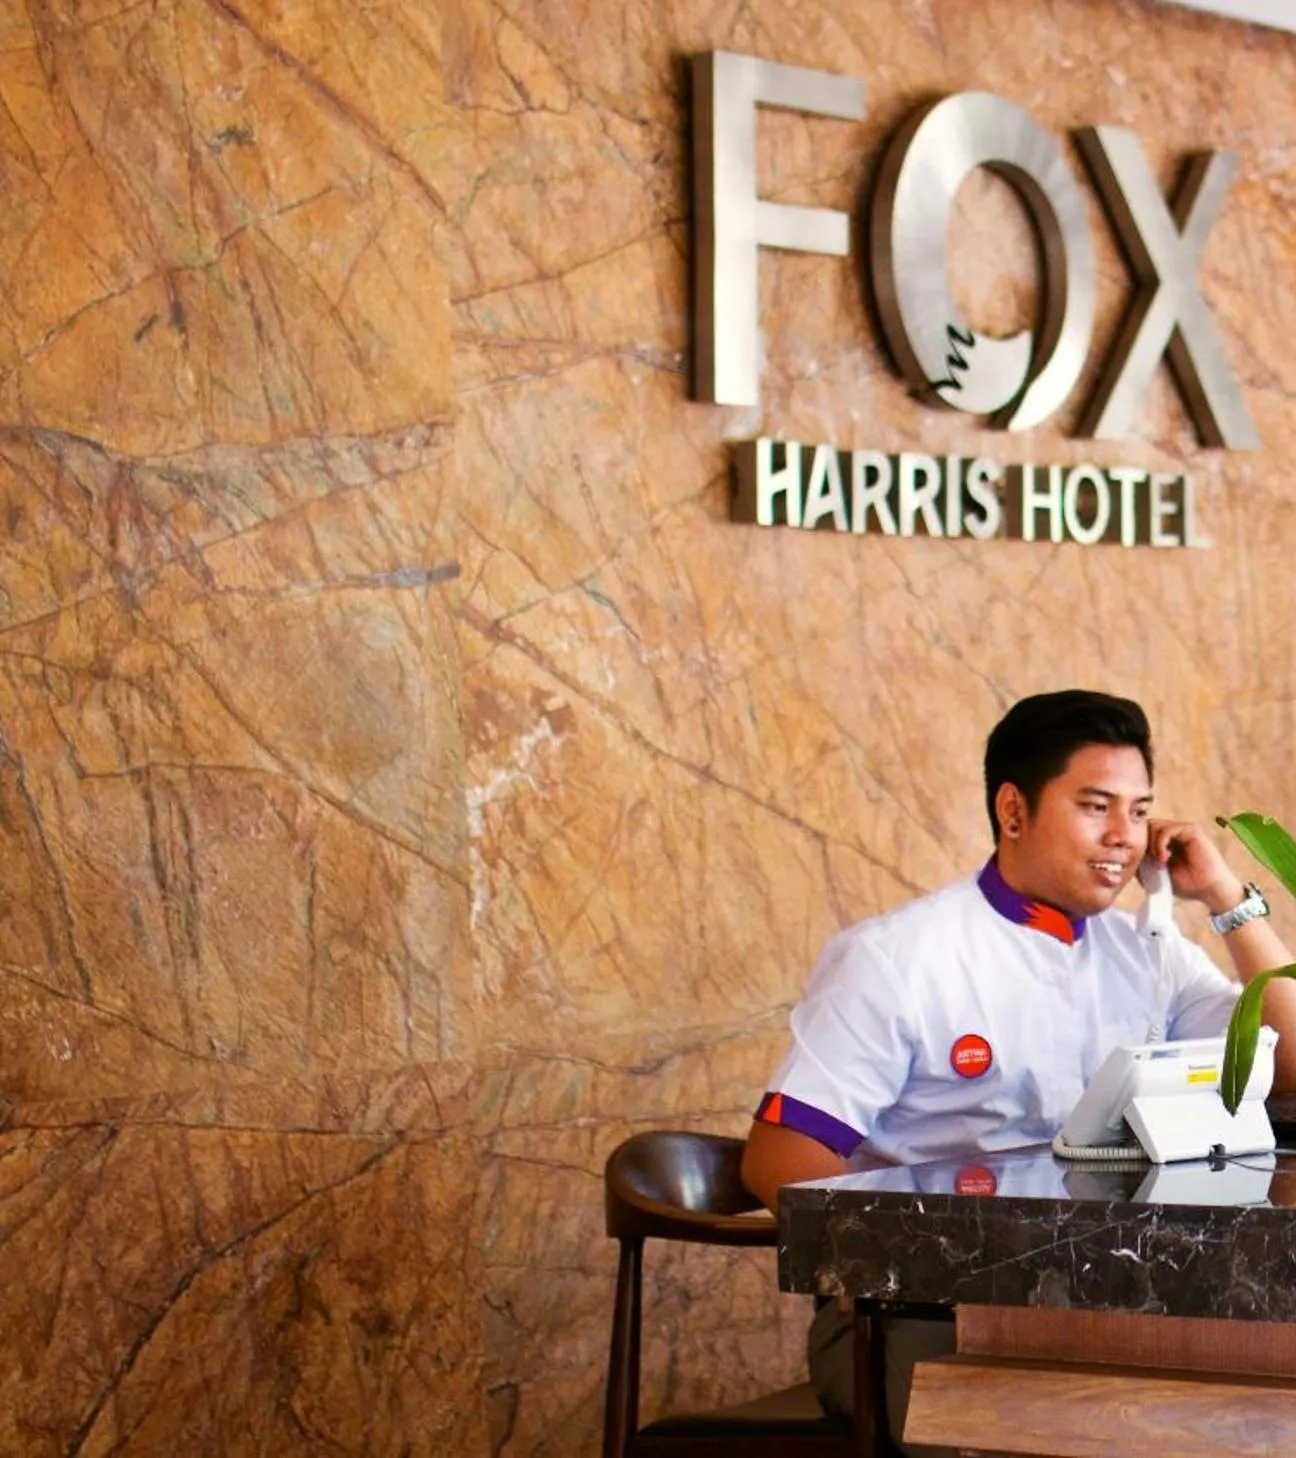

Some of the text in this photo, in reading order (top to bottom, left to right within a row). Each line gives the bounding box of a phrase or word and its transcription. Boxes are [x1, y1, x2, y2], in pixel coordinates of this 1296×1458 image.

[698, 49, 1262, 452] FOX
[754, 436, 1213, 549] HARRIS HOTEL
